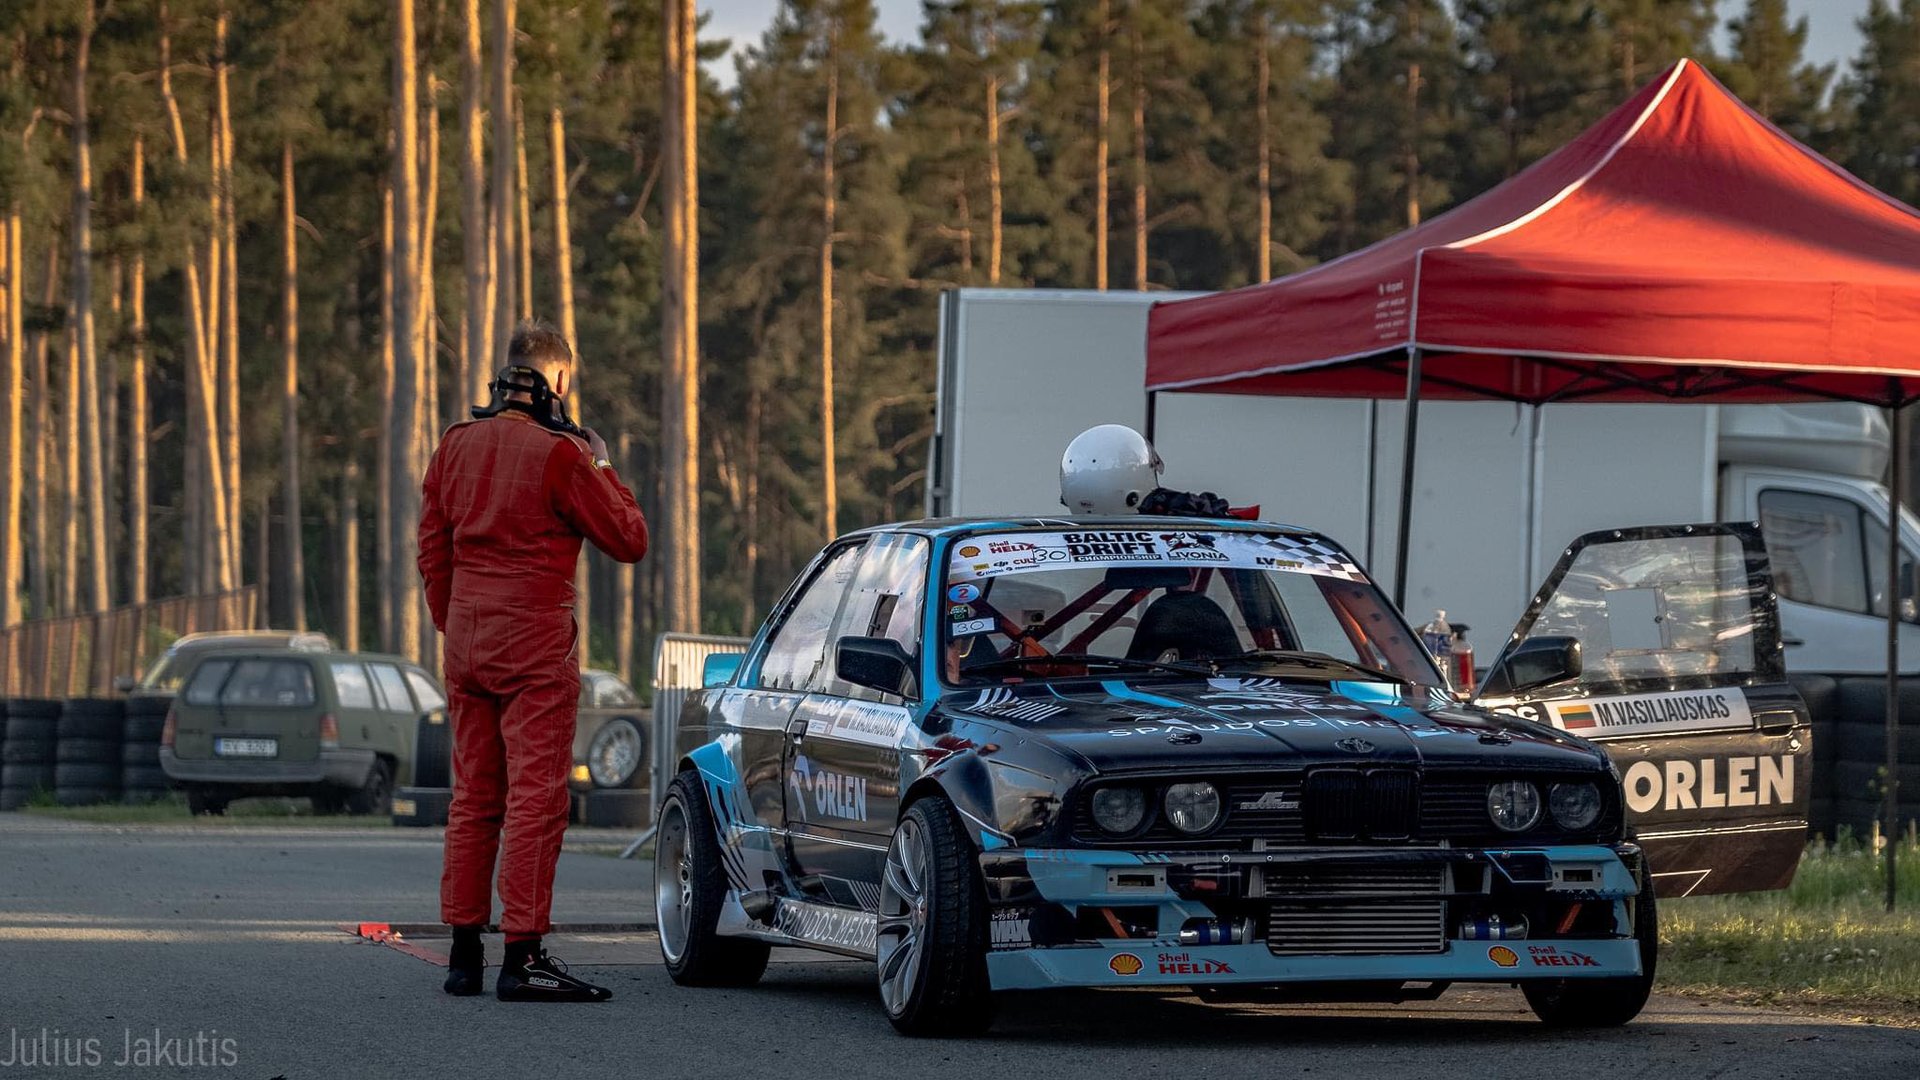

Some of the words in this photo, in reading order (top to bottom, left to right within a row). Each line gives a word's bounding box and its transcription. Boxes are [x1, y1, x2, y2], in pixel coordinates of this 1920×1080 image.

[1063, 532, 1153, 544] BALTIC
[990, 544, 1036, 554] HELIX
[1034, 548, 1067, 562] 30
[1067, 543, 1156, 555] DRIFT
[1077, 554, 1160, 562] CHAMPIONSHIP
[1167, 551, 1231, 560] LIVONIA
[958, 588, 969, 599] 2
[957, 620, 985, 633] 30
[1594, 694, 1731, 728] M.VASILIAUSKAS
[1624, 755, 1795, 813] ORLEN
[814, 769, 867, 822] ORLEN
[990, 919, 1032, 943] MAX
[1527, 945, 1557, 955] Shell
[1157, 952, 1190, 962] Shell
[1531, 955, 1600, 967] HELIX
[1158, 962, 1234, 975] HELIX
